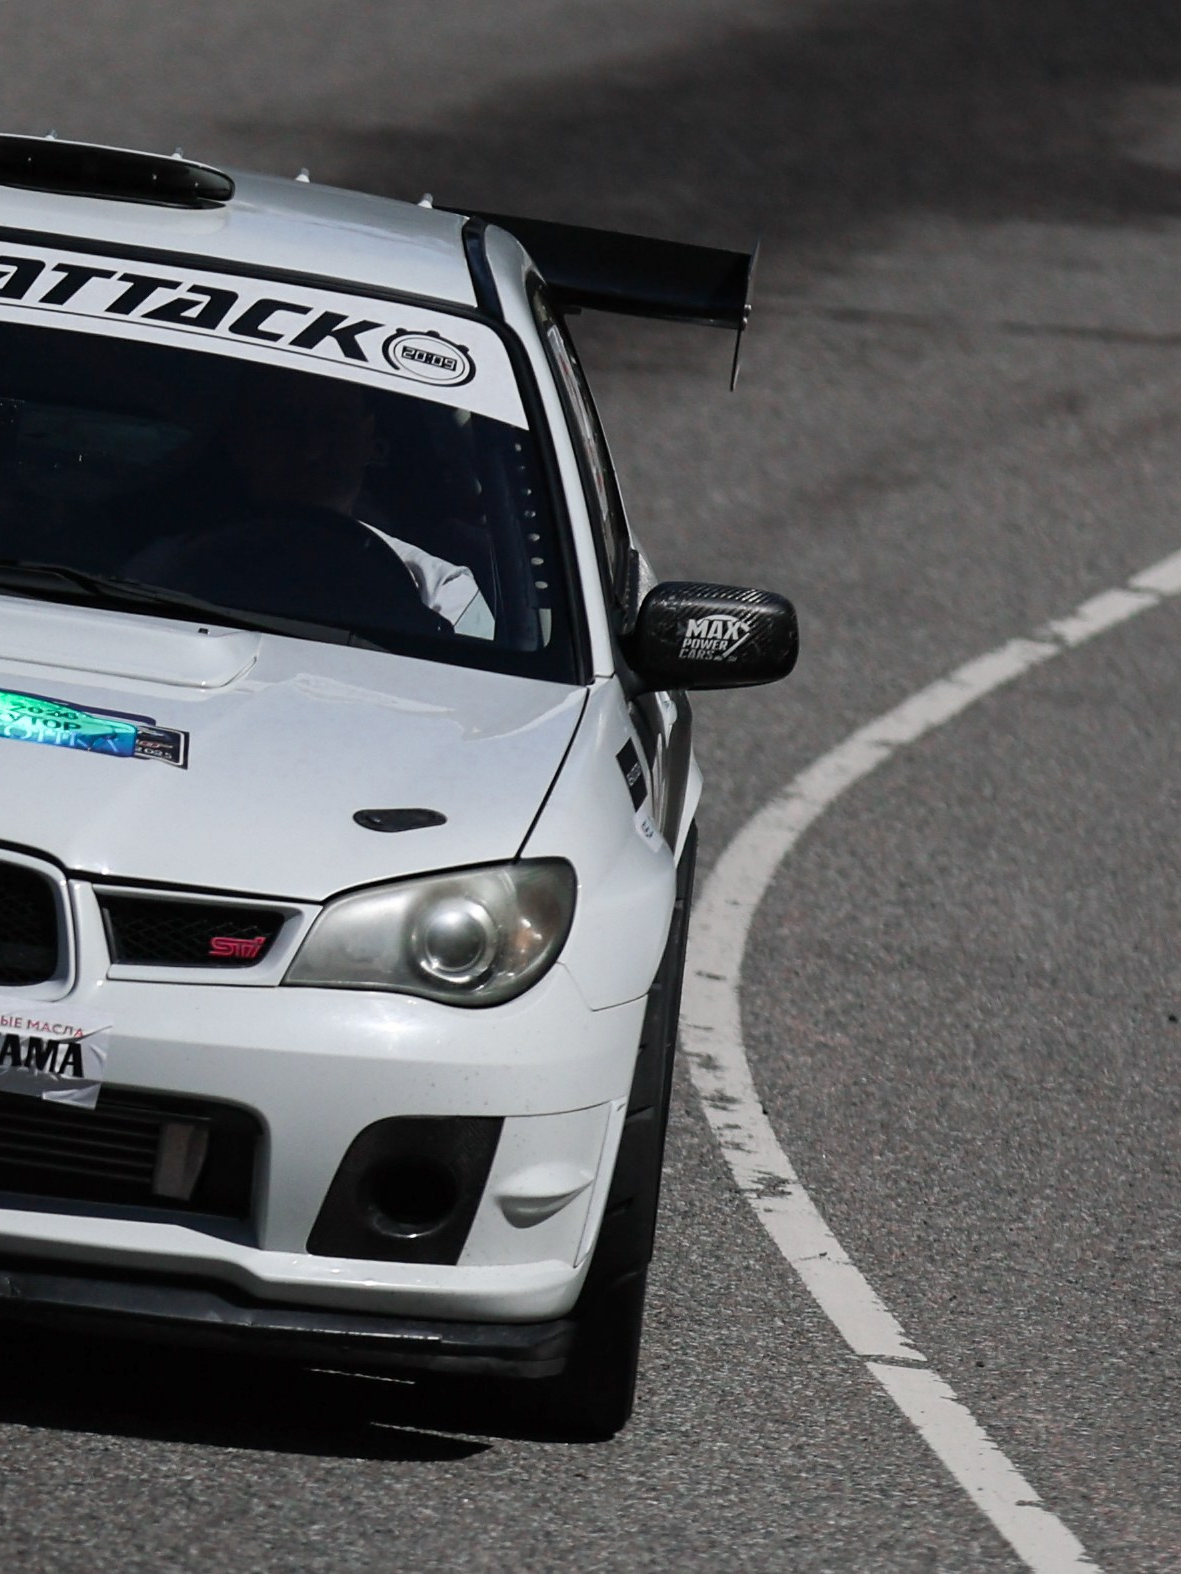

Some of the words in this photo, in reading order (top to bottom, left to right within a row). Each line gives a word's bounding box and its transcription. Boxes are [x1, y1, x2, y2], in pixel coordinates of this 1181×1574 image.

[402, 346, 457, 372] 20:09
[685, 618, 740, 640] MAX
[679, 648, 715, 660] CARS
[682, 638, 729, 651] POWER
[26, 1018, 86, 1039] МАСЛА
